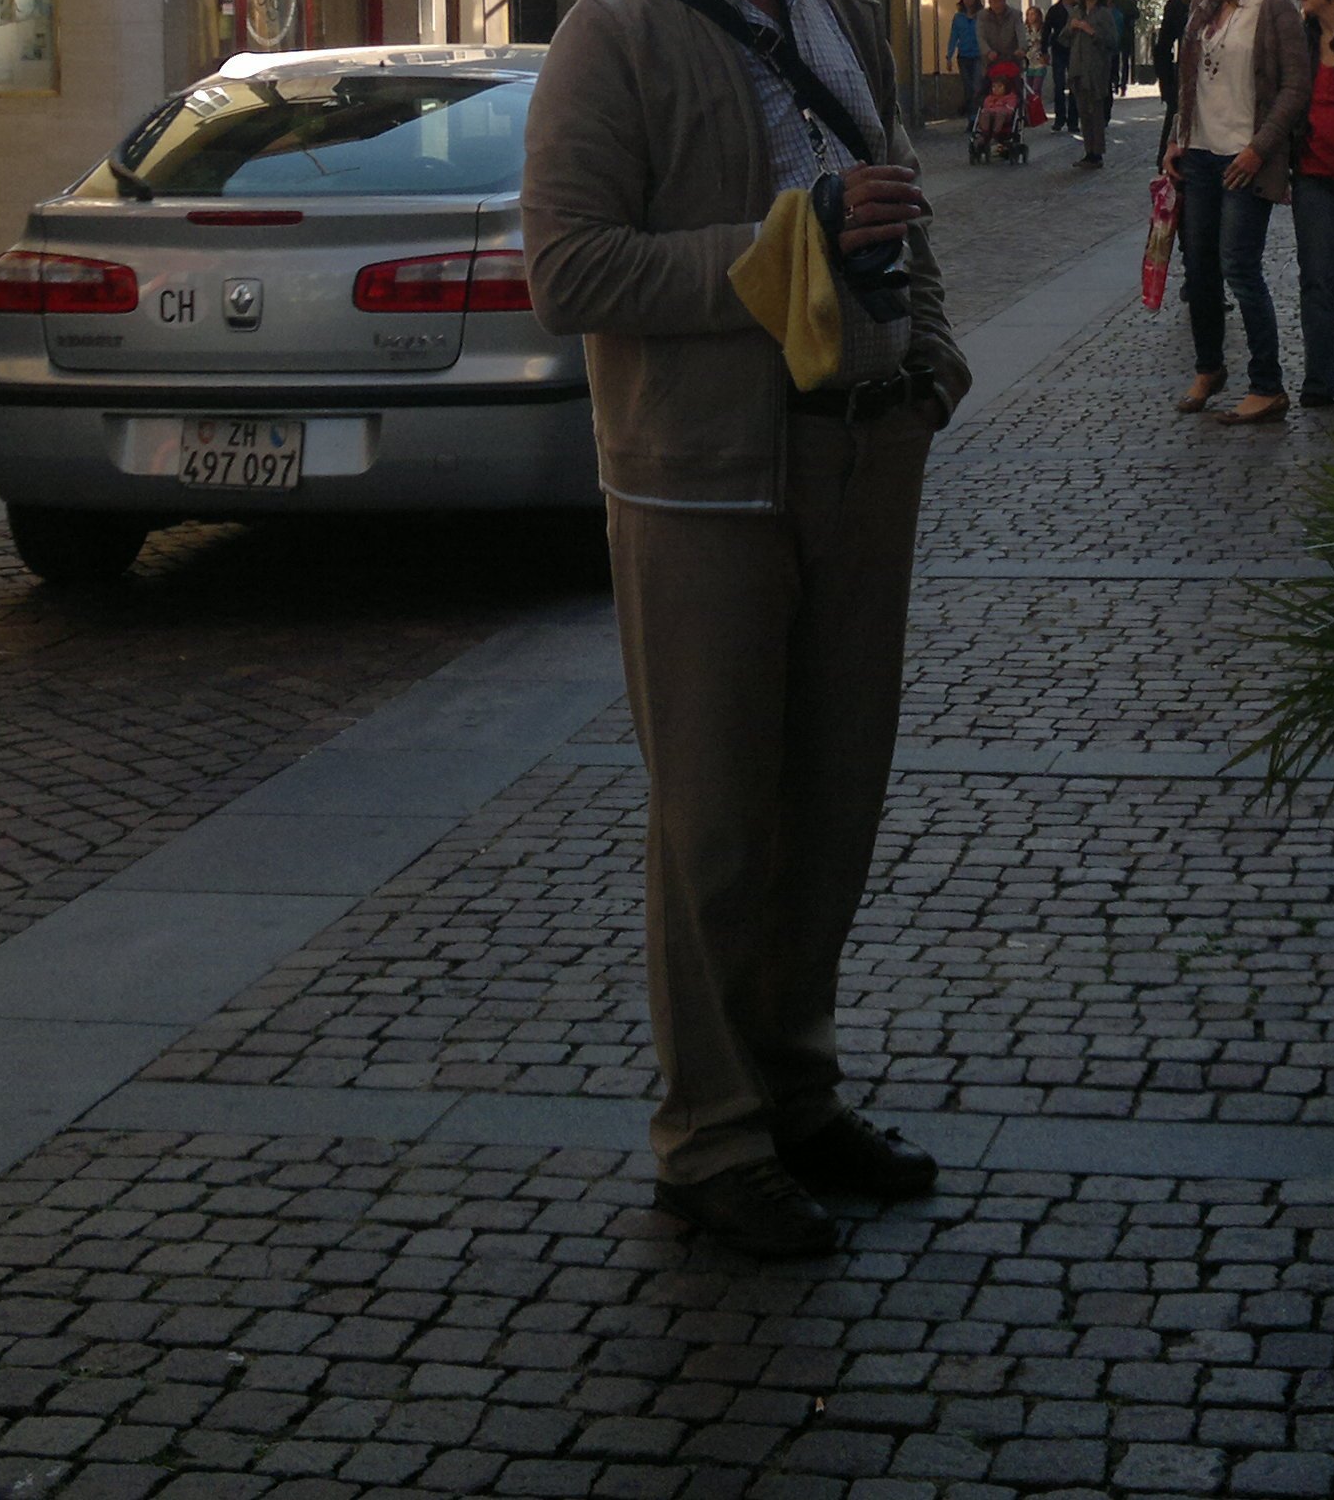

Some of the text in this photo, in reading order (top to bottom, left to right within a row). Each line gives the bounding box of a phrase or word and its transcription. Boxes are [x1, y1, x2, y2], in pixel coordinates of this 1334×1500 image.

[159, 289, 195, 325] CH
[227, 421, 257, 448] ZH
[182, 449, 297, 488] 497 097
